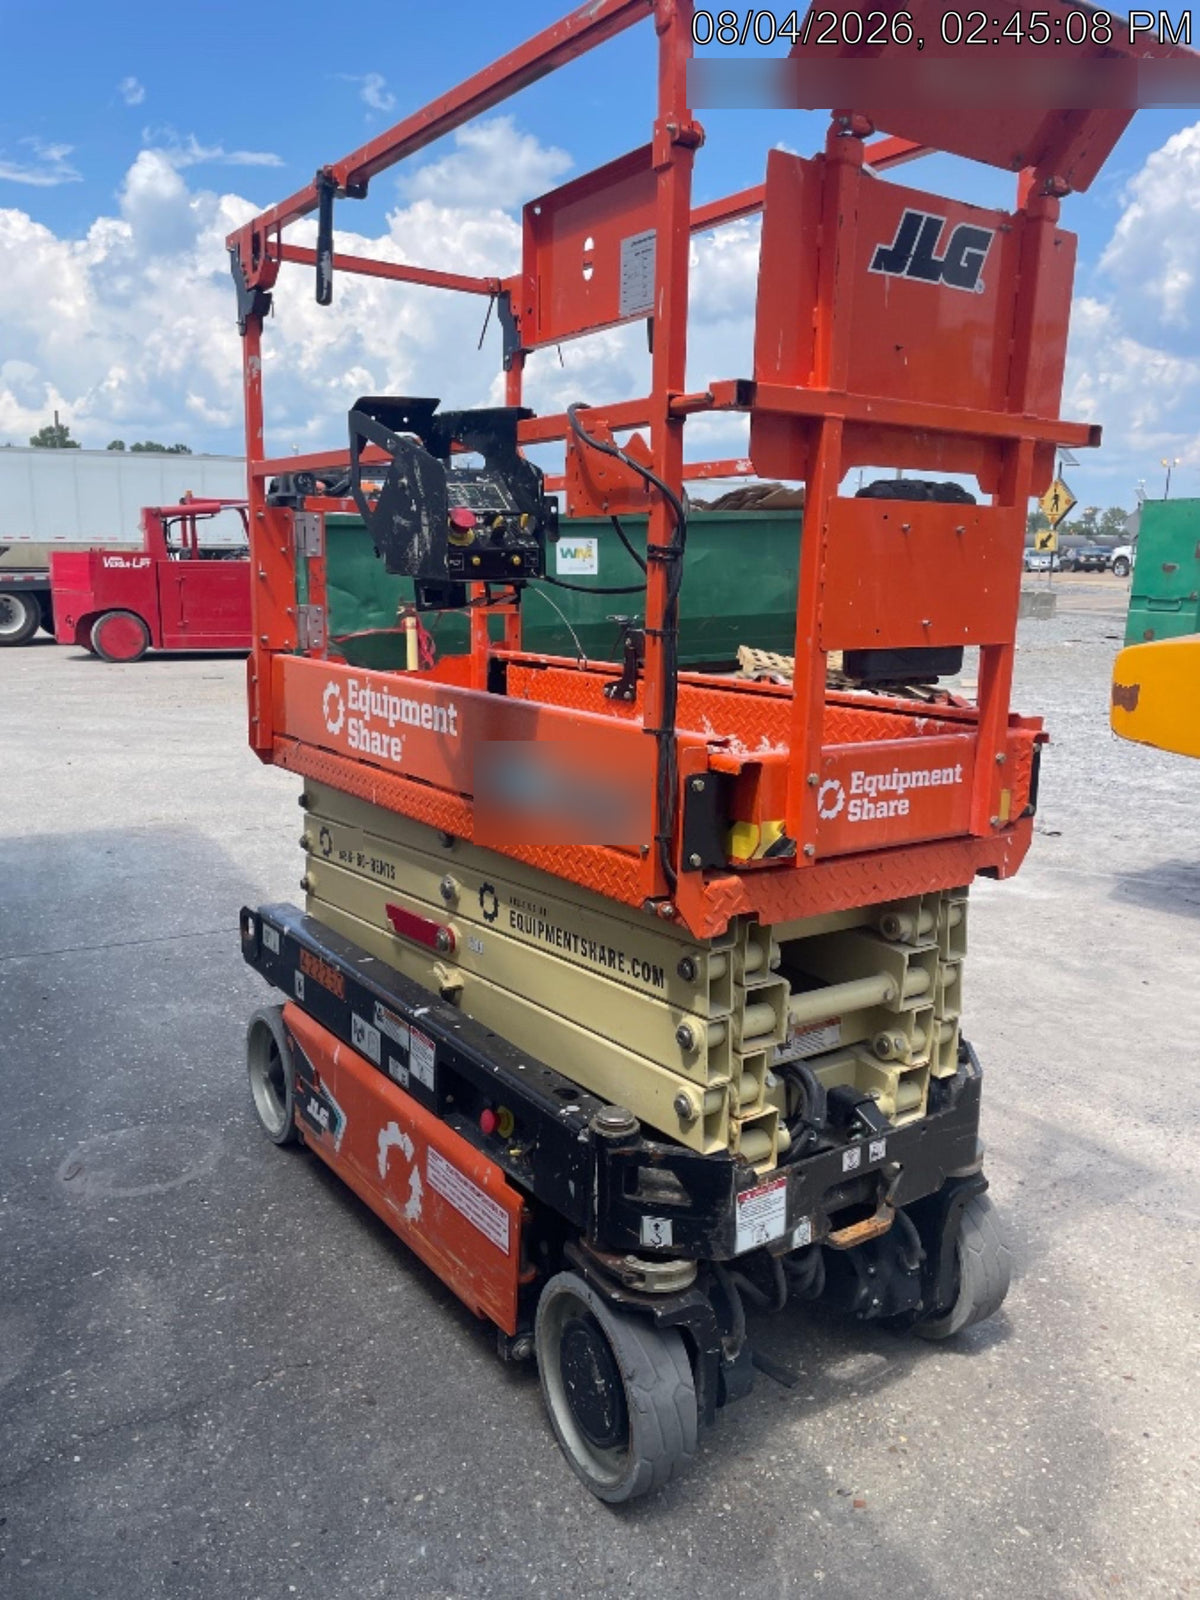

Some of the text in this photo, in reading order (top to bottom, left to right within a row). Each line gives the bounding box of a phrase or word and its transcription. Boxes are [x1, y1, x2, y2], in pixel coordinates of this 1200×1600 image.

[868, 208, 995, 293] JLG
[347, 677, 458, 737] Equipment
[347, 717, 404, 762] Share
[849, 763, 963, 797] Equipment
[847, 797, 910, 822] Share
[508, 910, 665, 989] EQUIPMENTSHARE.COM
[306, 1096, 330, 1129] JLG
